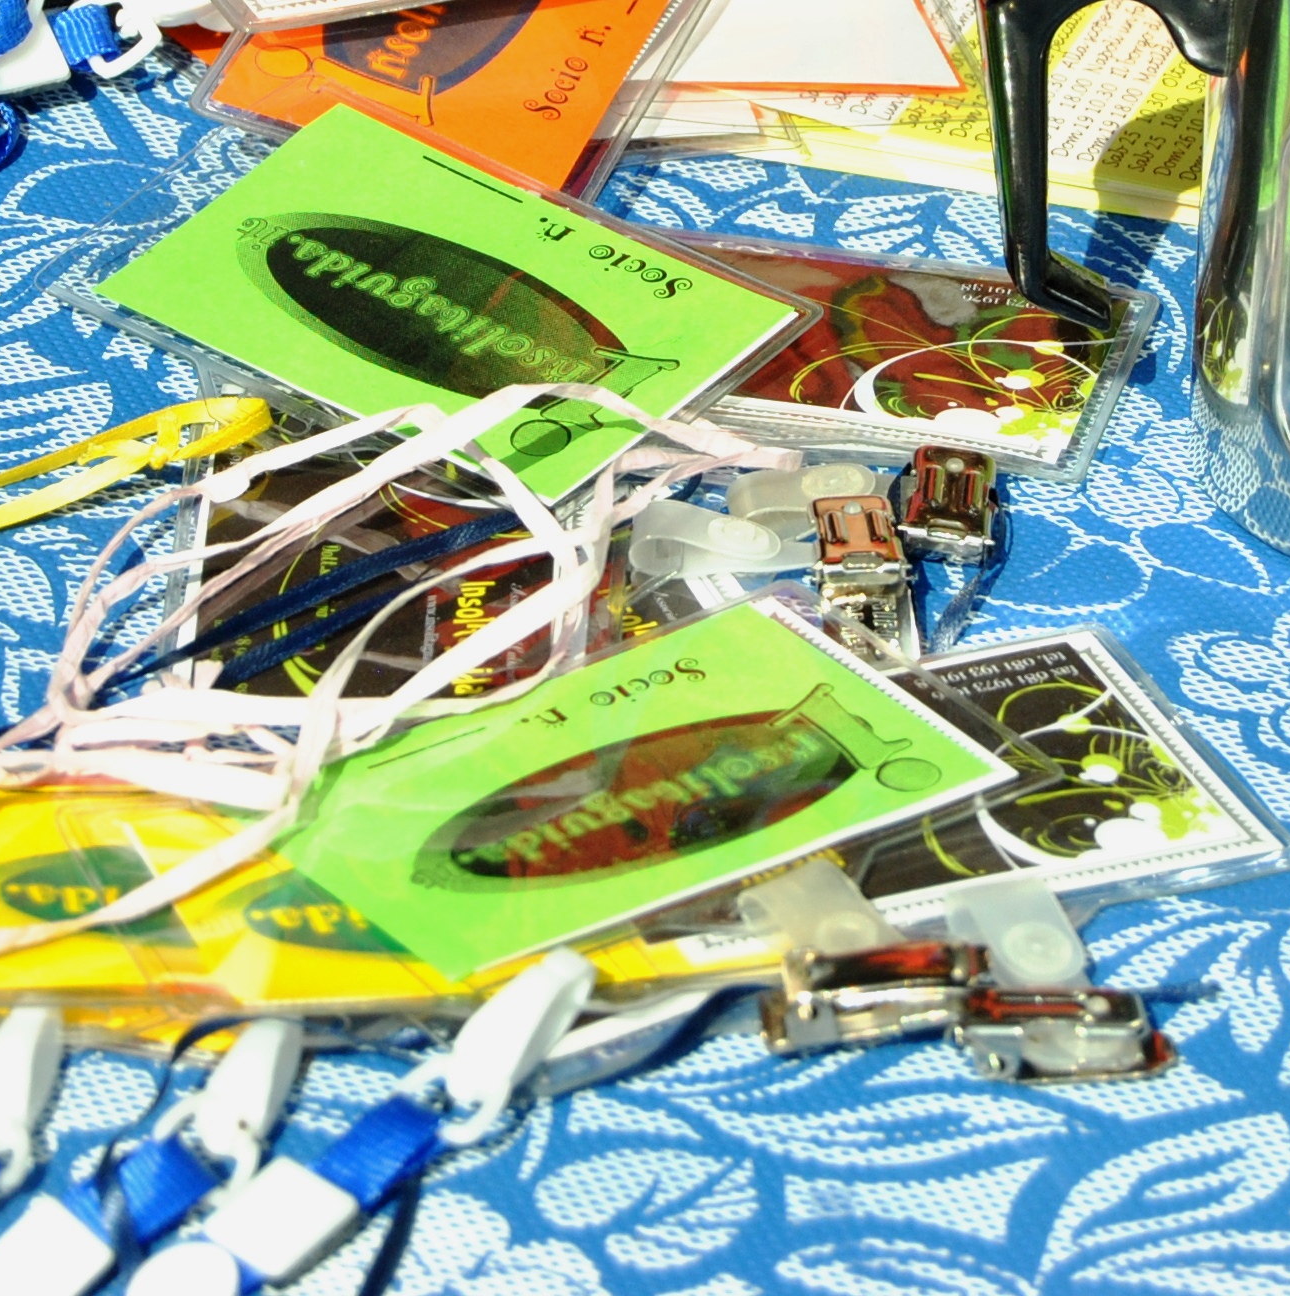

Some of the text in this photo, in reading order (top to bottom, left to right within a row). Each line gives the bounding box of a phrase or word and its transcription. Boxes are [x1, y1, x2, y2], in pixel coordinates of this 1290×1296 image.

[522, 56, 590, 122] Socio
[1060, 77, 1092, 109] 18.00
[1051, 131, 1083, 158] Dom
[1074, 115, 1094, 130] 19
[1085, 82, 1118, 114] 10.30
[1077, 135, 1109, 162] Dom
[1099, 120, 1120, 134] 19
[1111, 87, 1143, 119] 18.00
[1102, 141, 1128, 168] Sab
[1119, 131, 1141, 145] 25
[1135, 92, 1168, 124] 10.30
[1128, 146, 1154, 172] Sab
[1144, 135, 1166, 150] 25
[1161, 97, 1193, 129] 18.00
[1153, 146, 1185, 177] Dom
[1174, 134, 1195, 150] 26
[588, 243, 693, 301] Socio
[966, 661, 1001, 678] 193
[1001, 655, 1037, 672] 081
[1014, 669, 1051, 687] 081
[1035, 649, 1068, 665] tel.
[1048, 663, 1081, 680] fax
[589, 656, 707, 707] Socio
[970, 675, 1014, 694] 1973
